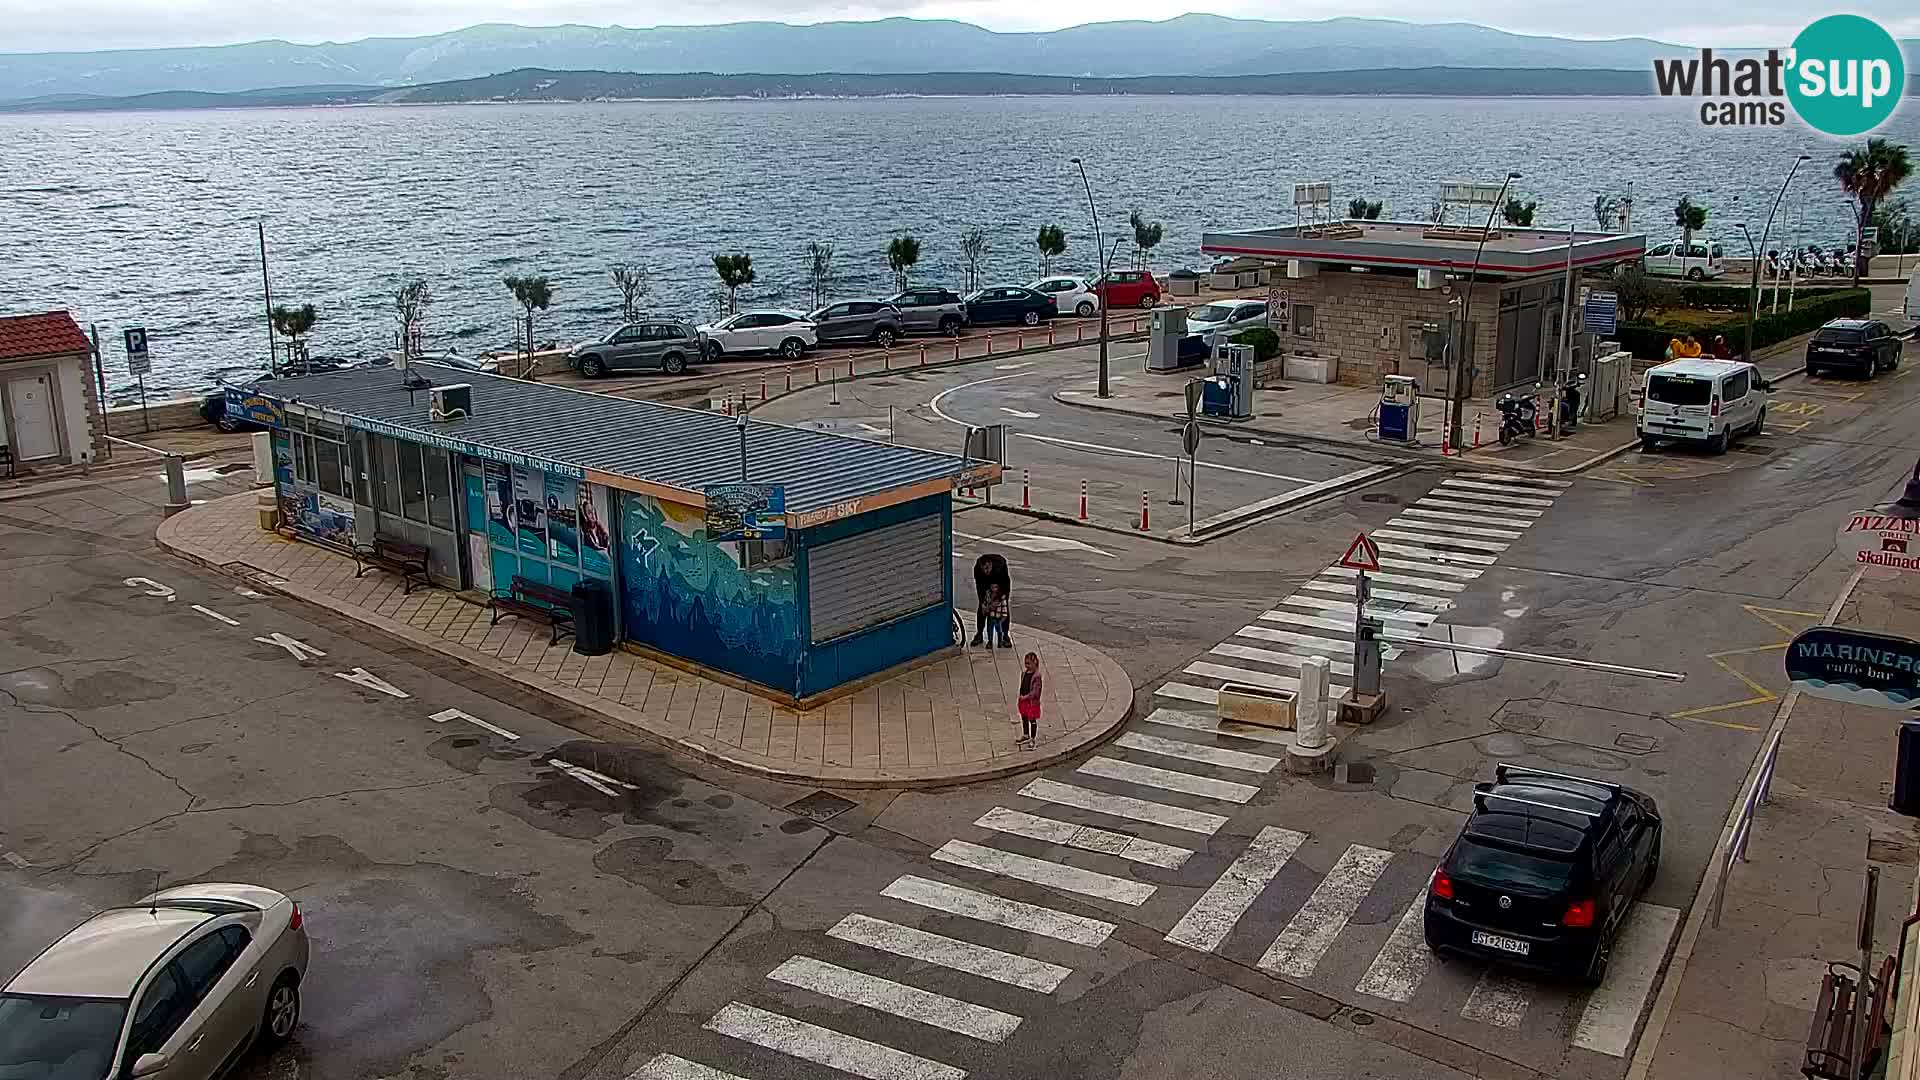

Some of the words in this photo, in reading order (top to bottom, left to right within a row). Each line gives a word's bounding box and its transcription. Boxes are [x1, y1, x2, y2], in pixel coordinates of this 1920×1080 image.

[436, 438, 466, 453] POSTAJA
[477, 448, 492, 458] BUS
[493, 451, 525, 465] STATION
[528, 458, 553, 472] TICKET
[554, 463, 581, 478] OFFICE
[1867, 666, 1894, 680] bar
